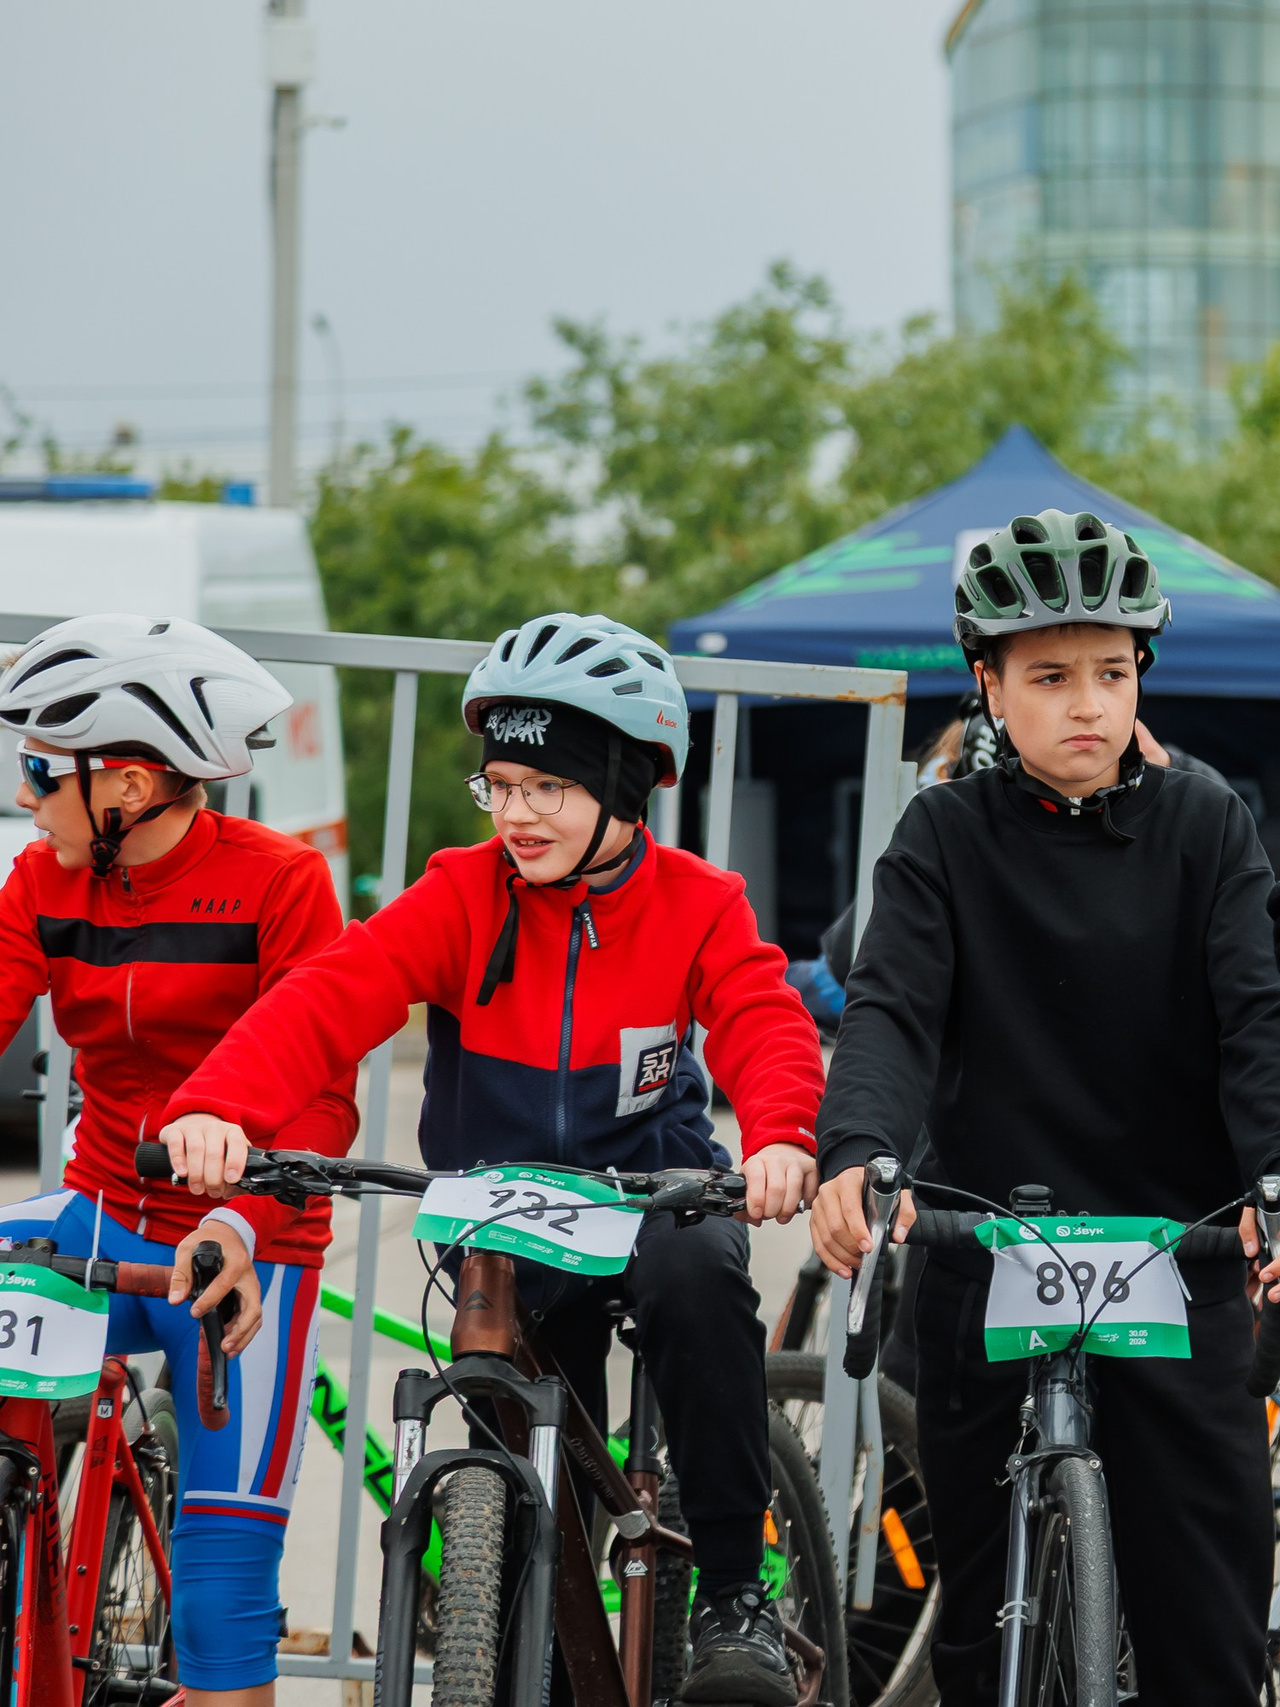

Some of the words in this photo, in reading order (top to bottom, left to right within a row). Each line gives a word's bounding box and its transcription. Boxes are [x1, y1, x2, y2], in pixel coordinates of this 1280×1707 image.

[190, 897, 242, 915] MAAP
[583, 912, 599, 948] STARPLAY
[535, 1173, 567, 1187] Звук
[1072, 1225, 1104, 1237] Звук
[5, 1273, 37, 1287] Звук
[1036, 1261, 1130, 1306] 896
[1128, 1329, 1148, 1338] 30.05
[1128, 1337, 1147, 1345] 2026
